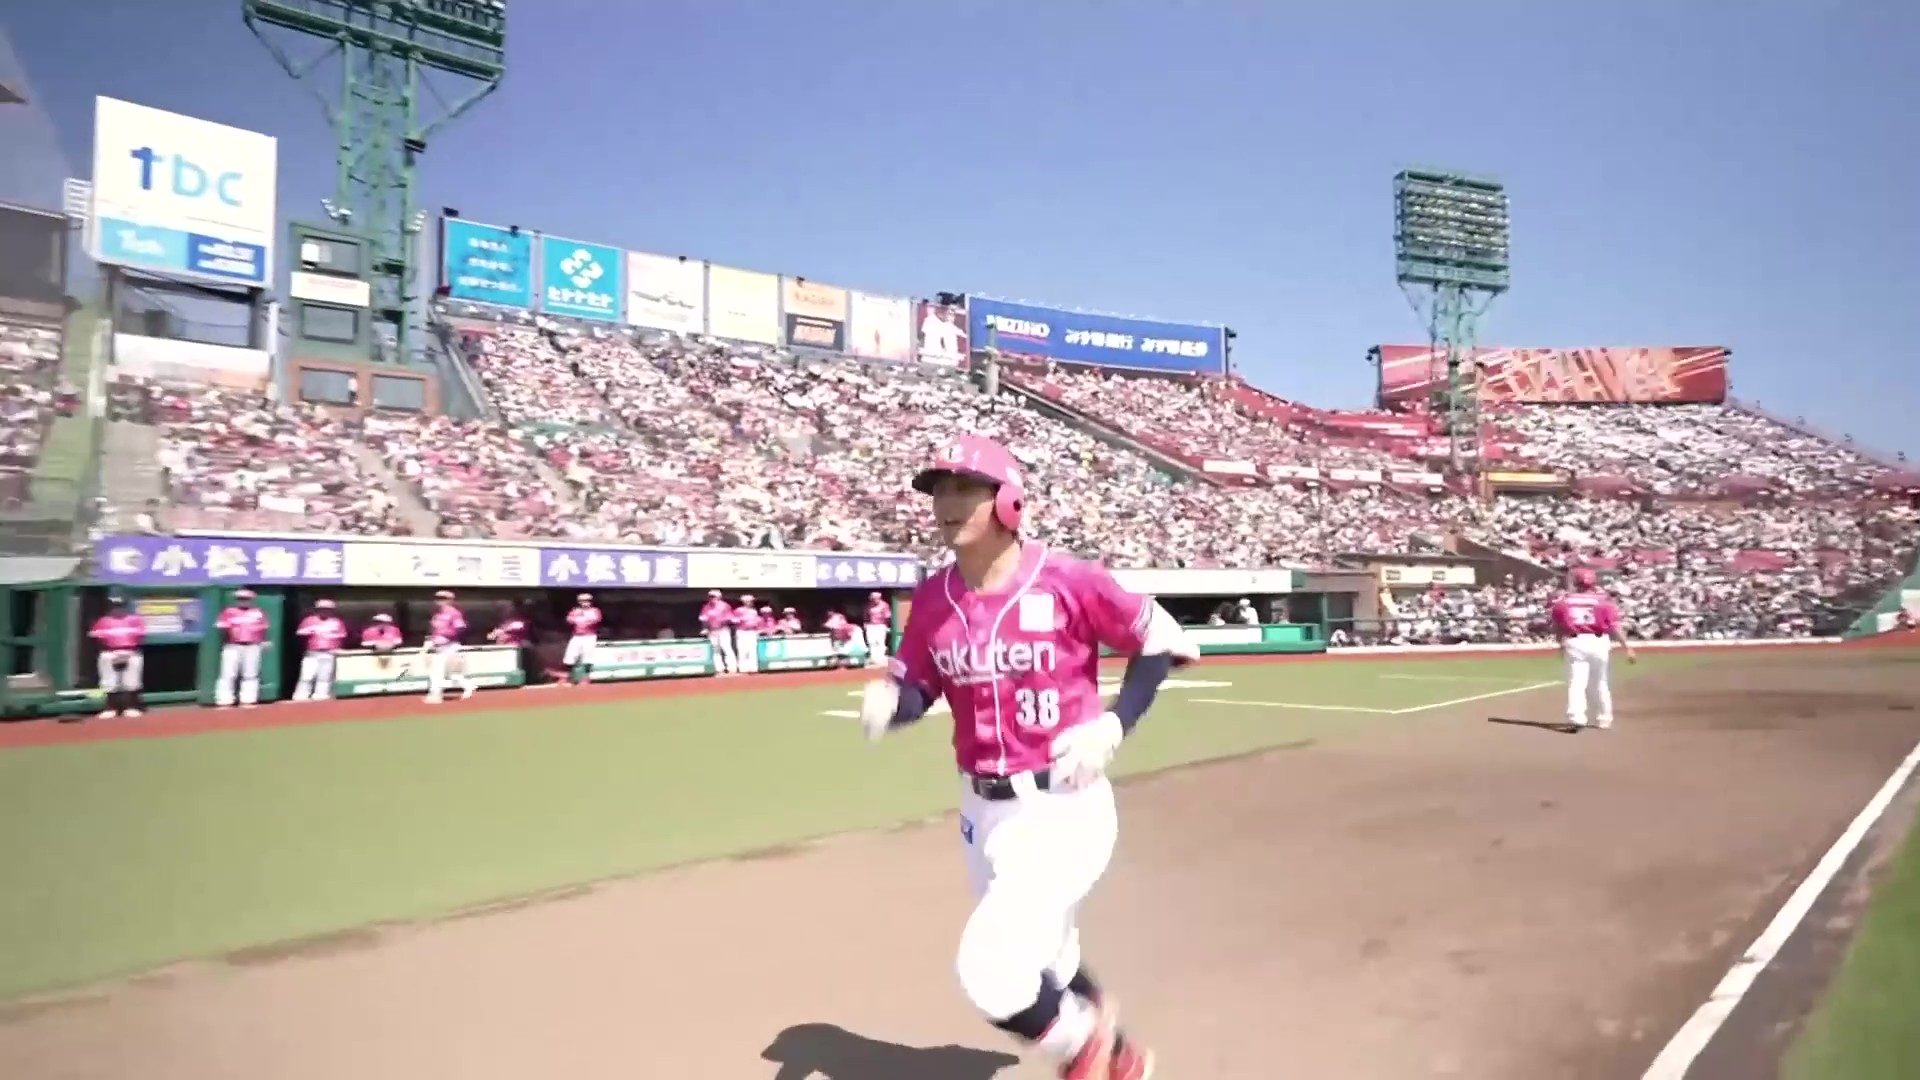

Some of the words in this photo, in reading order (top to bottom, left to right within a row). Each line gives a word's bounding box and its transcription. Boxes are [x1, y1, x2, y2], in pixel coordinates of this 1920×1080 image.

[129, 145, 243, 208] tbc
[151, 544, 342, 580] 小松物産
[547, 554, 684, 583] 小松物産
[1014, 688, 1061, 728] 38
